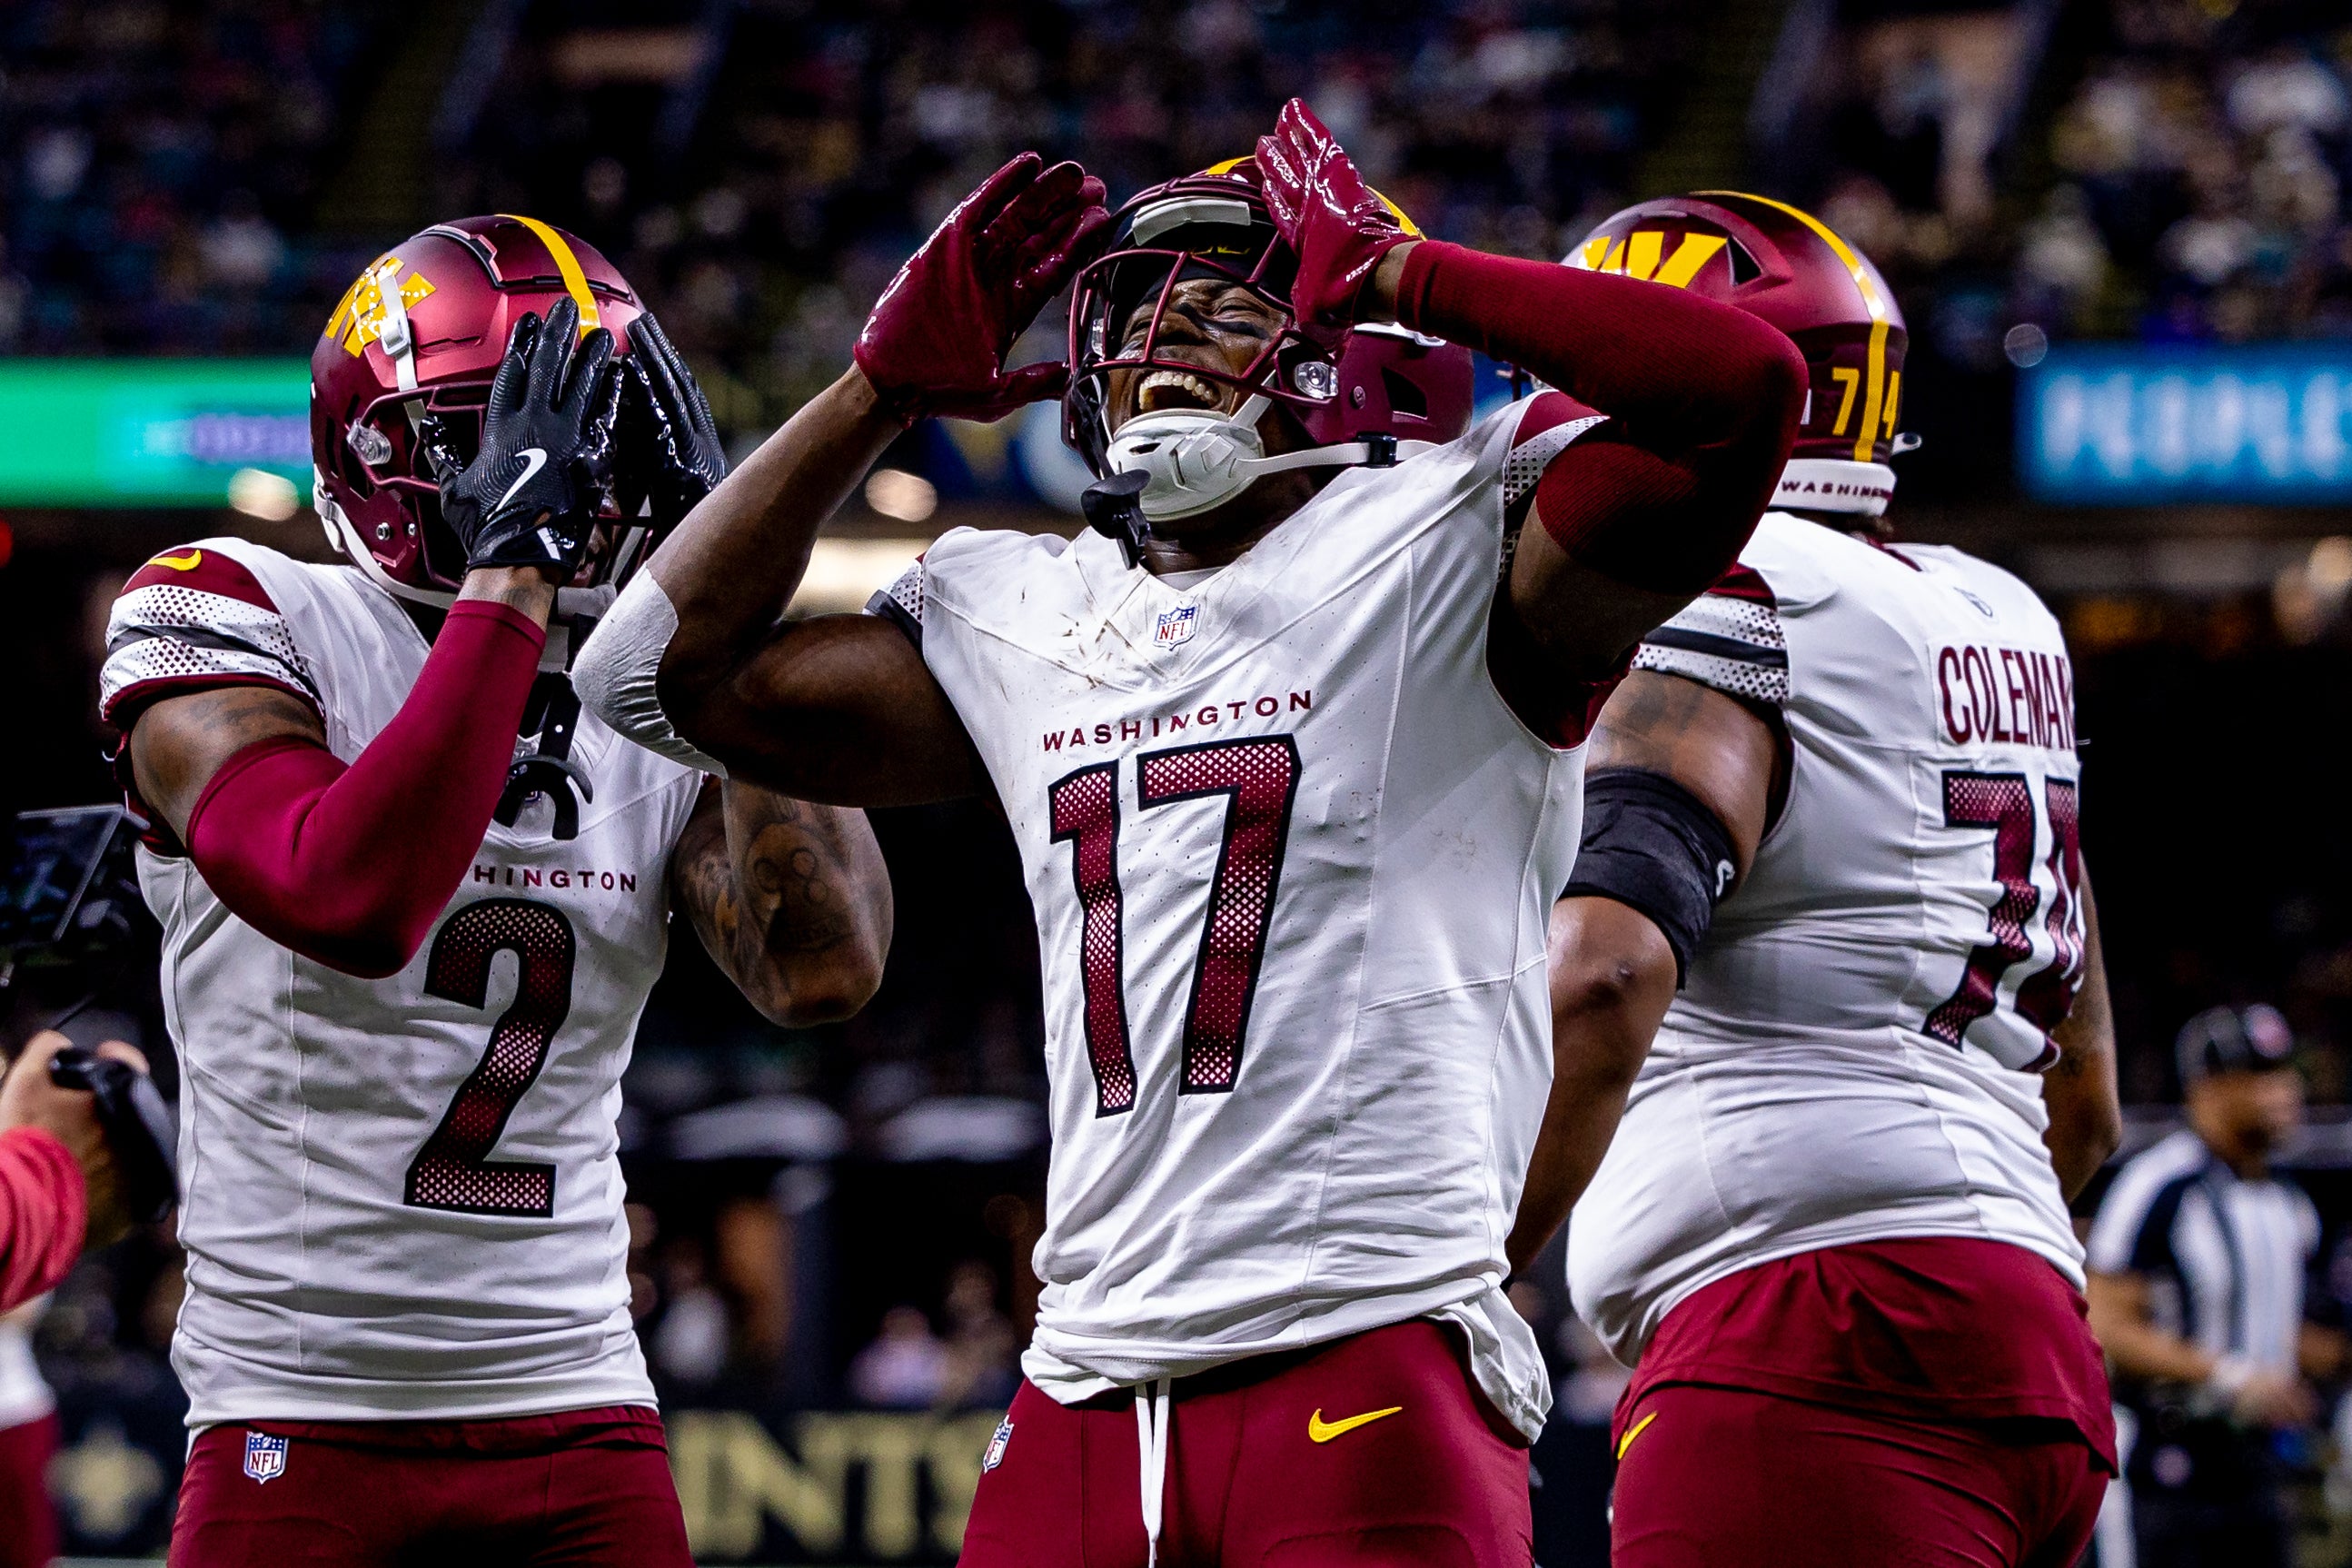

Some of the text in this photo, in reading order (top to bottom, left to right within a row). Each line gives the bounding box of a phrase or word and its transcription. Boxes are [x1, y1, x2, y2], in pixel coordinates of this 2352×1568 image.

[1831, 367, 1900, 440] 74
[1159, 621, 1186, 640] NFL
[1043, 690, 1312, 752] WASHINGTON
[473, 865, 636, 892] HINGTON
[1048, 733, 1302, 1119] 17
[1920, 769, 2087, 1073] 74
[403, 898, 576, 1218] 2
[251, 1452, 279, 1473] NFL
[667, 1410, 1007, 1559] INTS
